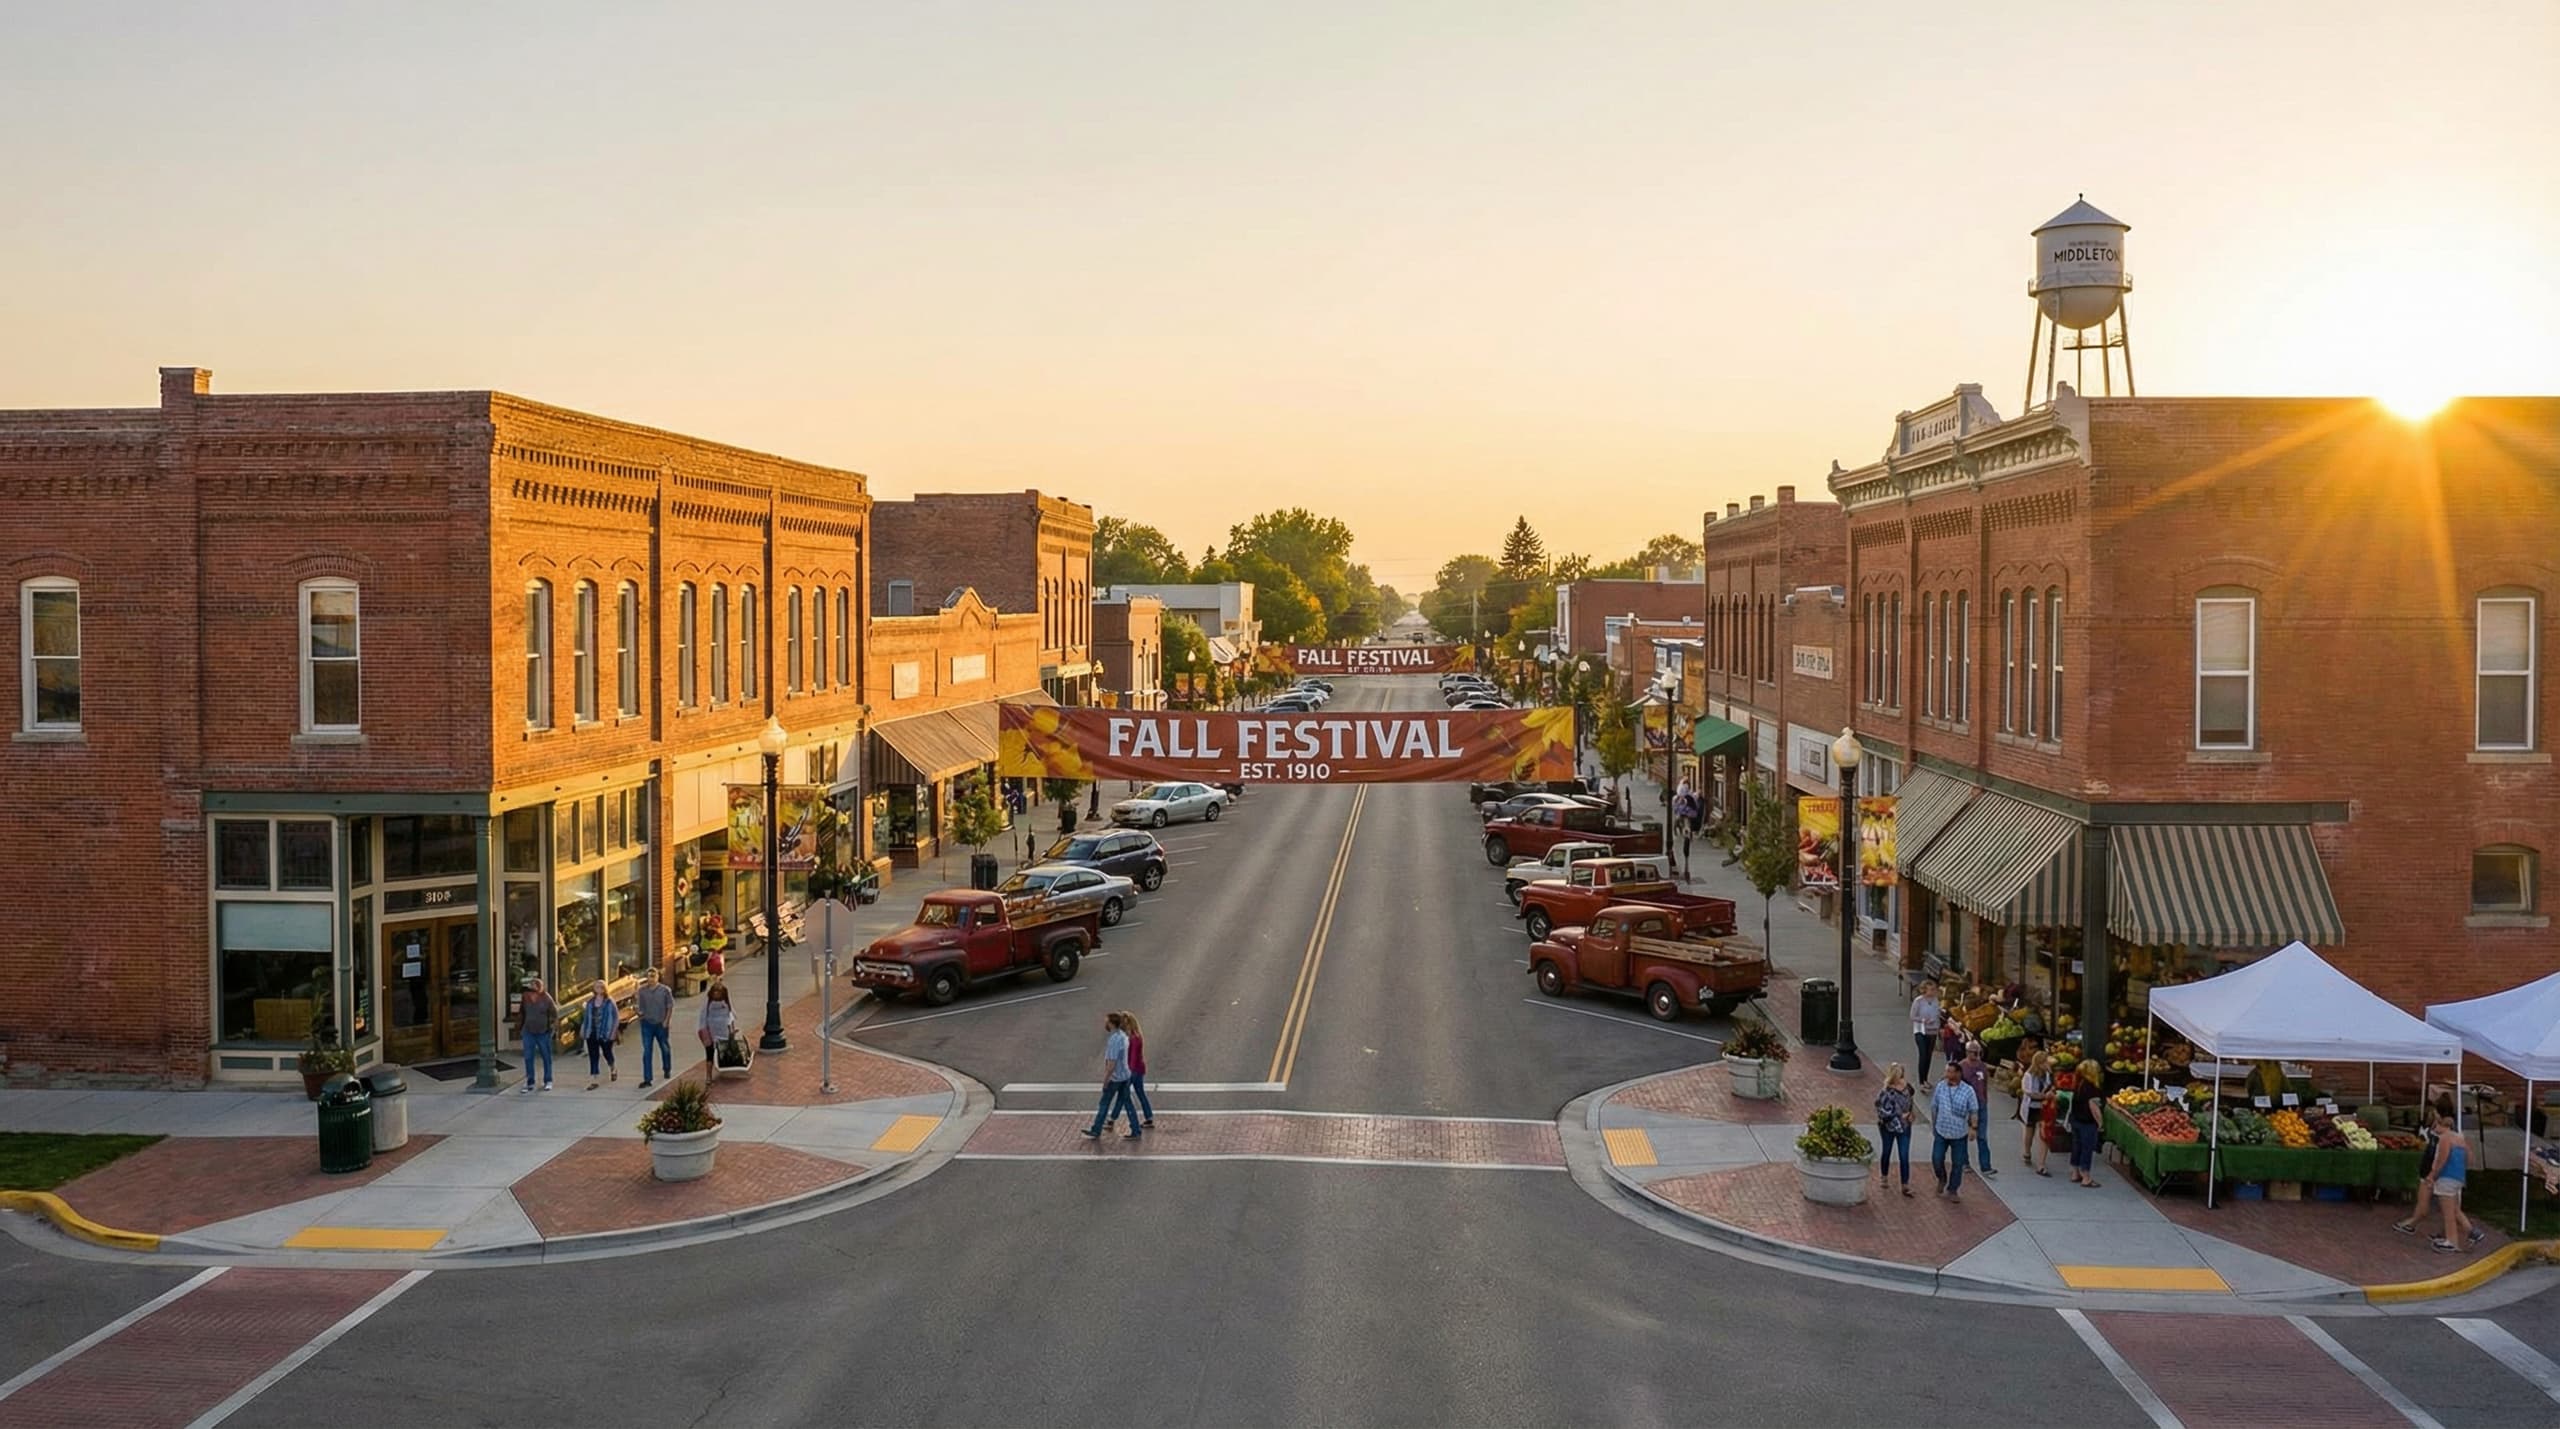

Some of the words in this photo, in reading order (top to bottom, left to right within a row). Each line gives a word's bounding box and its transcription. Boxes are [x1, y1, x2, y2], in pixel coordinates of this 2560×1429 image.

[2054, 248, 2121, 263] MIDDLETON
[1298, 649, 1342, 665] FALL
[1347, 649, 1434, 666] FESTIVAL
[1108, 718, 1222, 759] FALL
[1237, 719, 1465, 760] FESTIVAL
[1239, 763, 1281, 779] EST.
[1286, 763, 1331, 779] 1910
